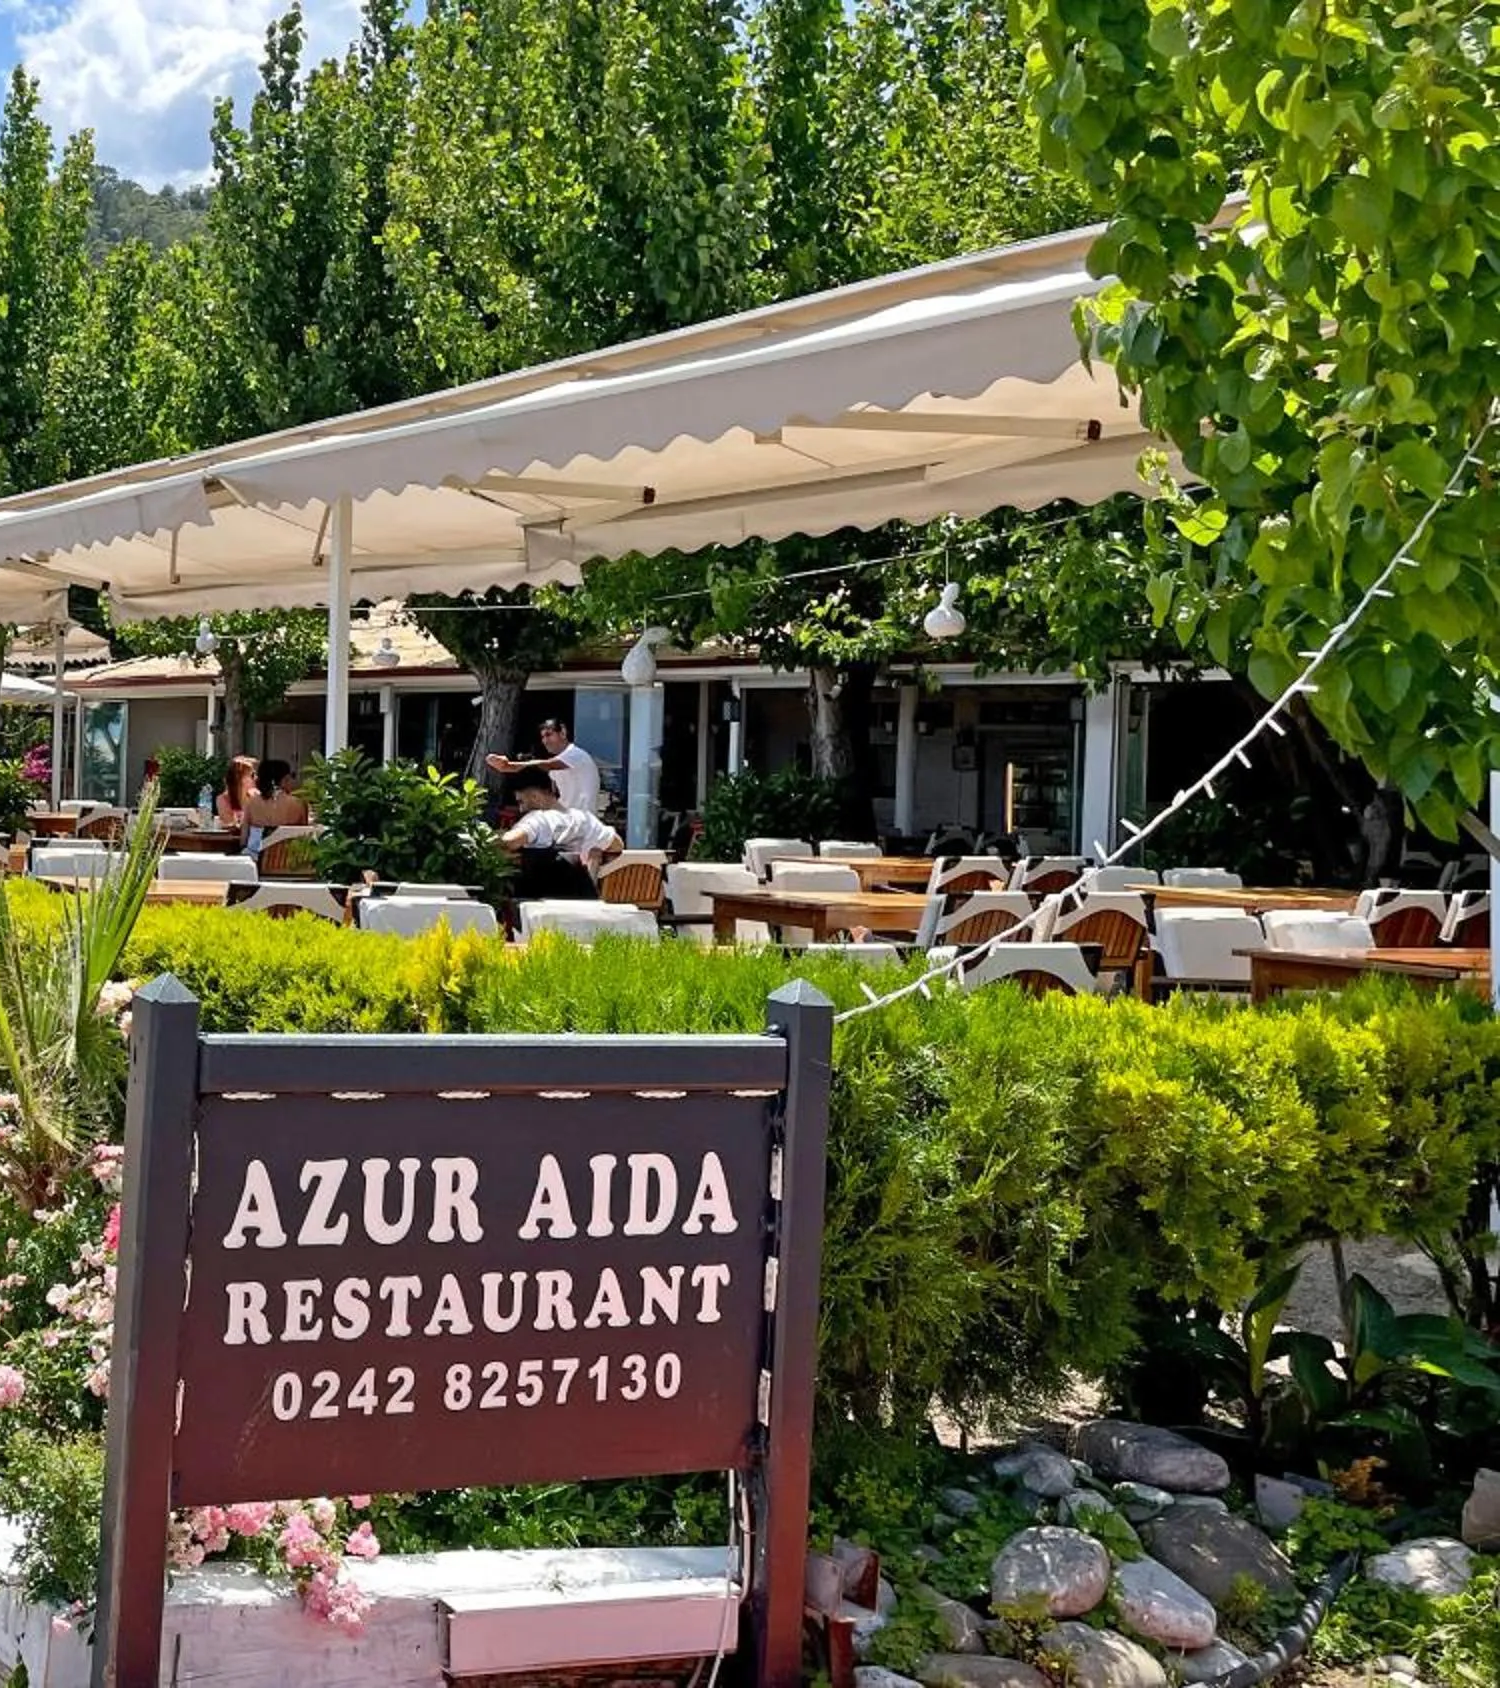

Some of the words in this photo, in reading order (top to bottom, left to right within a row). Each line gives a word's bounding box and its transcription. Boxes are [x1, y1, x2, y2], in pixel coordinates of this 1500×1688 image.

[223, 1156, 484, 1249] AZUR
[518, 1151, 738, 1240] AIDA
[223, 1263, 731, 1345] RESTAURANT
[272, 1367, 415, 1421] 0242
[443, 1353, 682, 1411] 8257130
